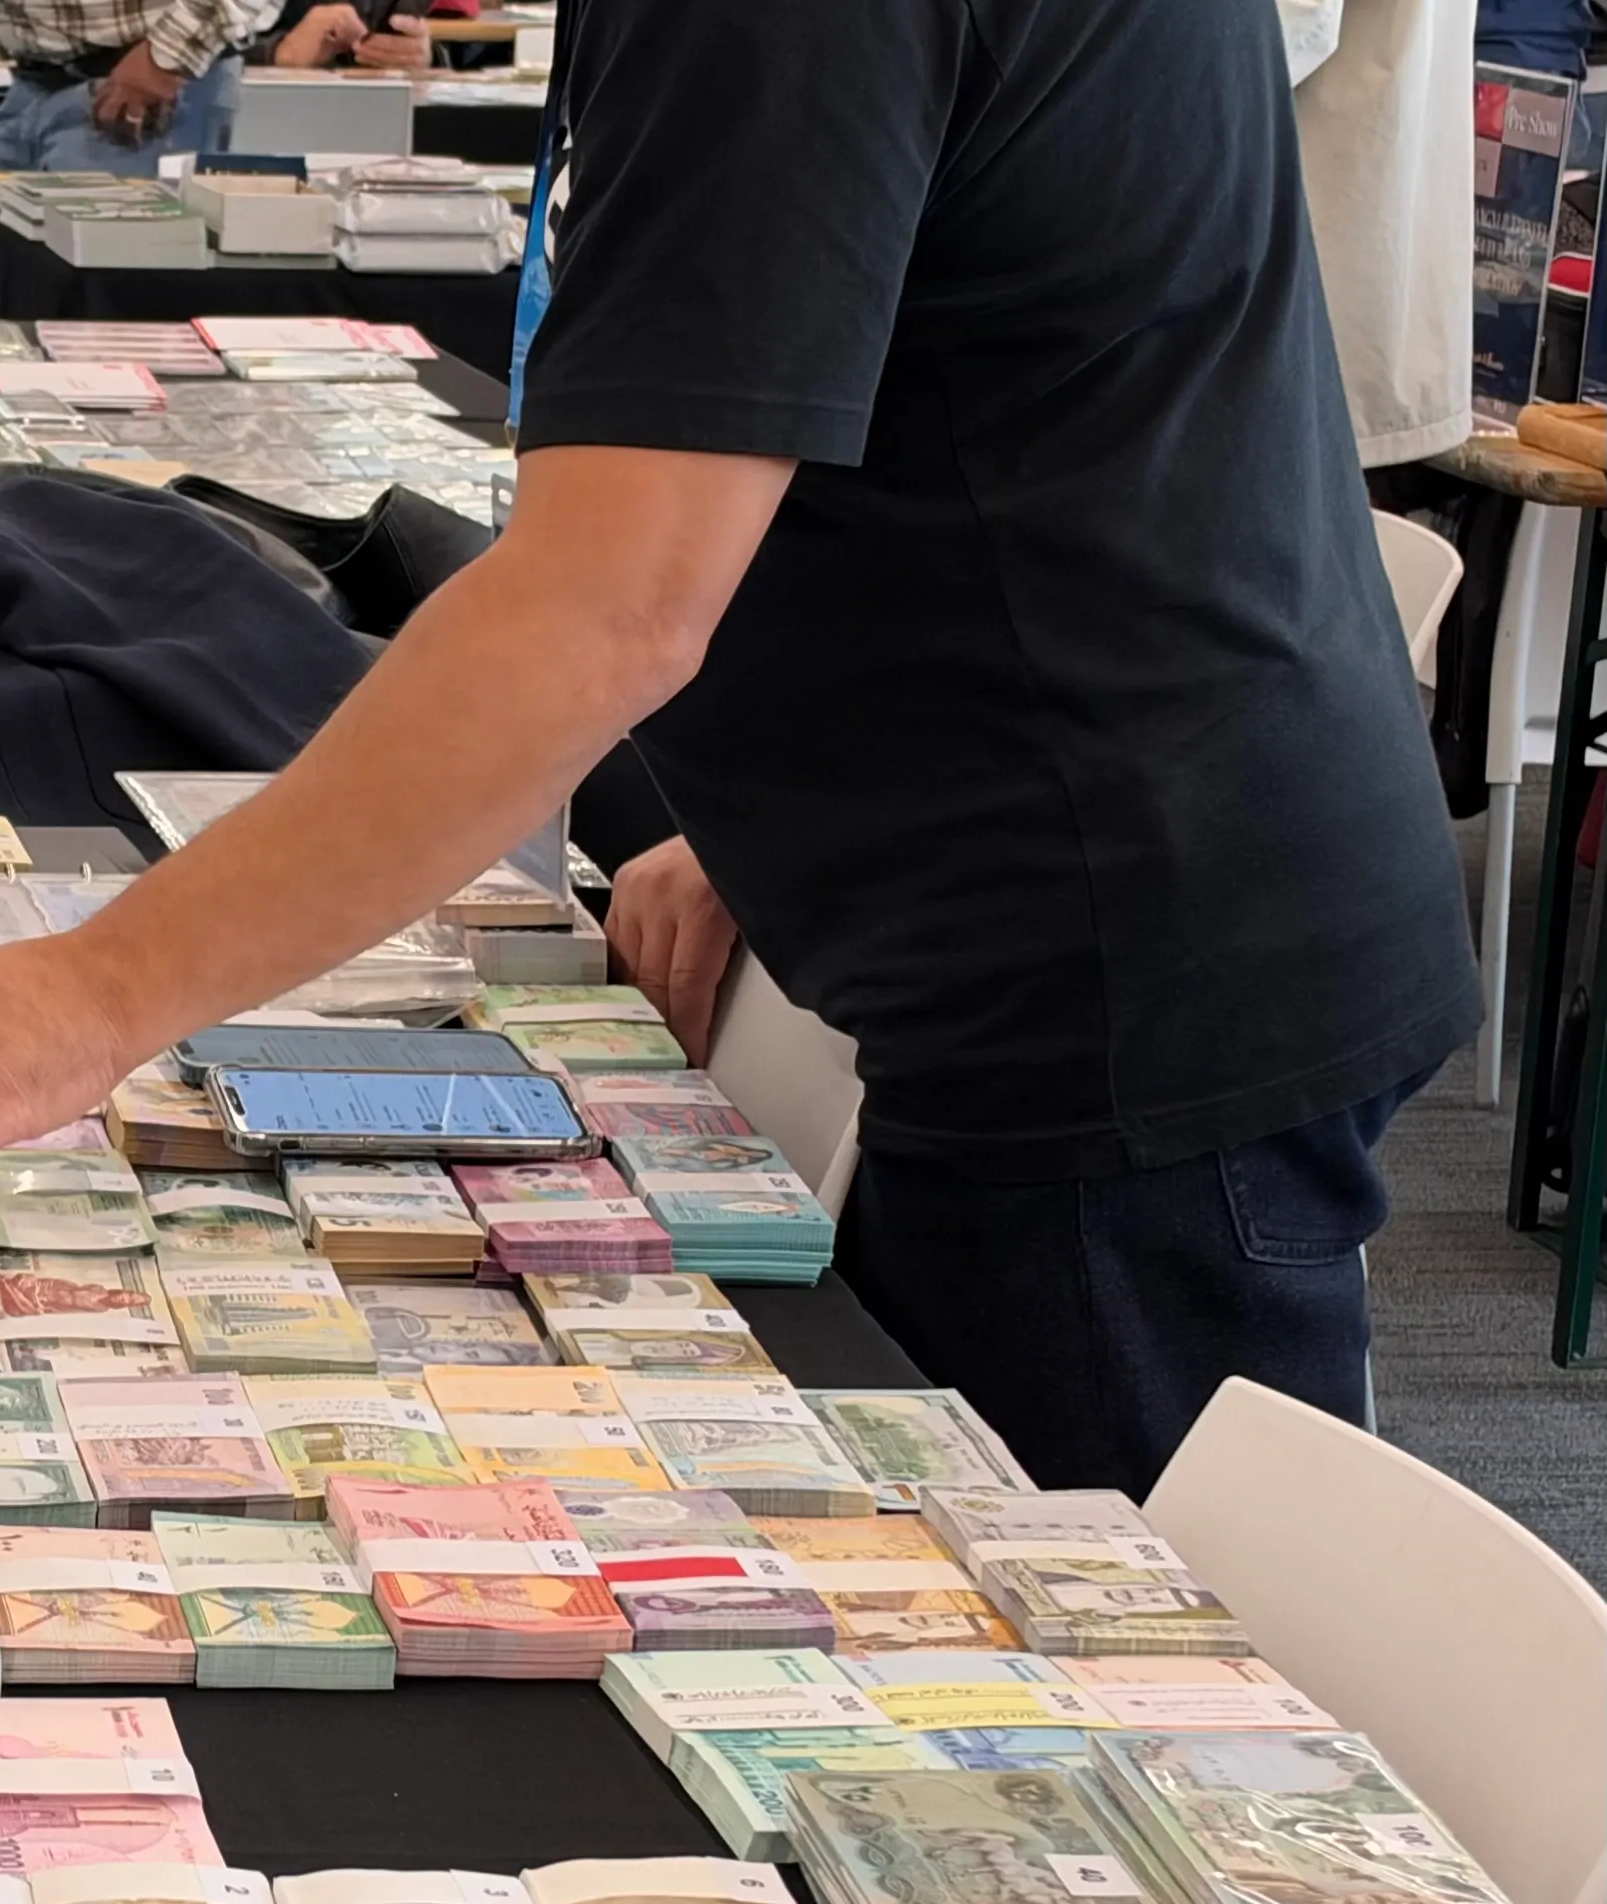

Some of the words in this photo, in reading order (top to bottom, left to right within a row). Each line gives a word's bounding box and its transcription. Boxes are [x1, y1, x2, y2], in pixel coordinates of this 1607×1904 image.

[551, 1549, 579, 1567] 320
[152, 1769, 175, 1781] 10
[1078, 1868, 1107, 1882] 40
[740, 1879, 764, 1887] 6
[225, 1885, 249, 1894] 2
[484, 1889, 508, 1897] 3
